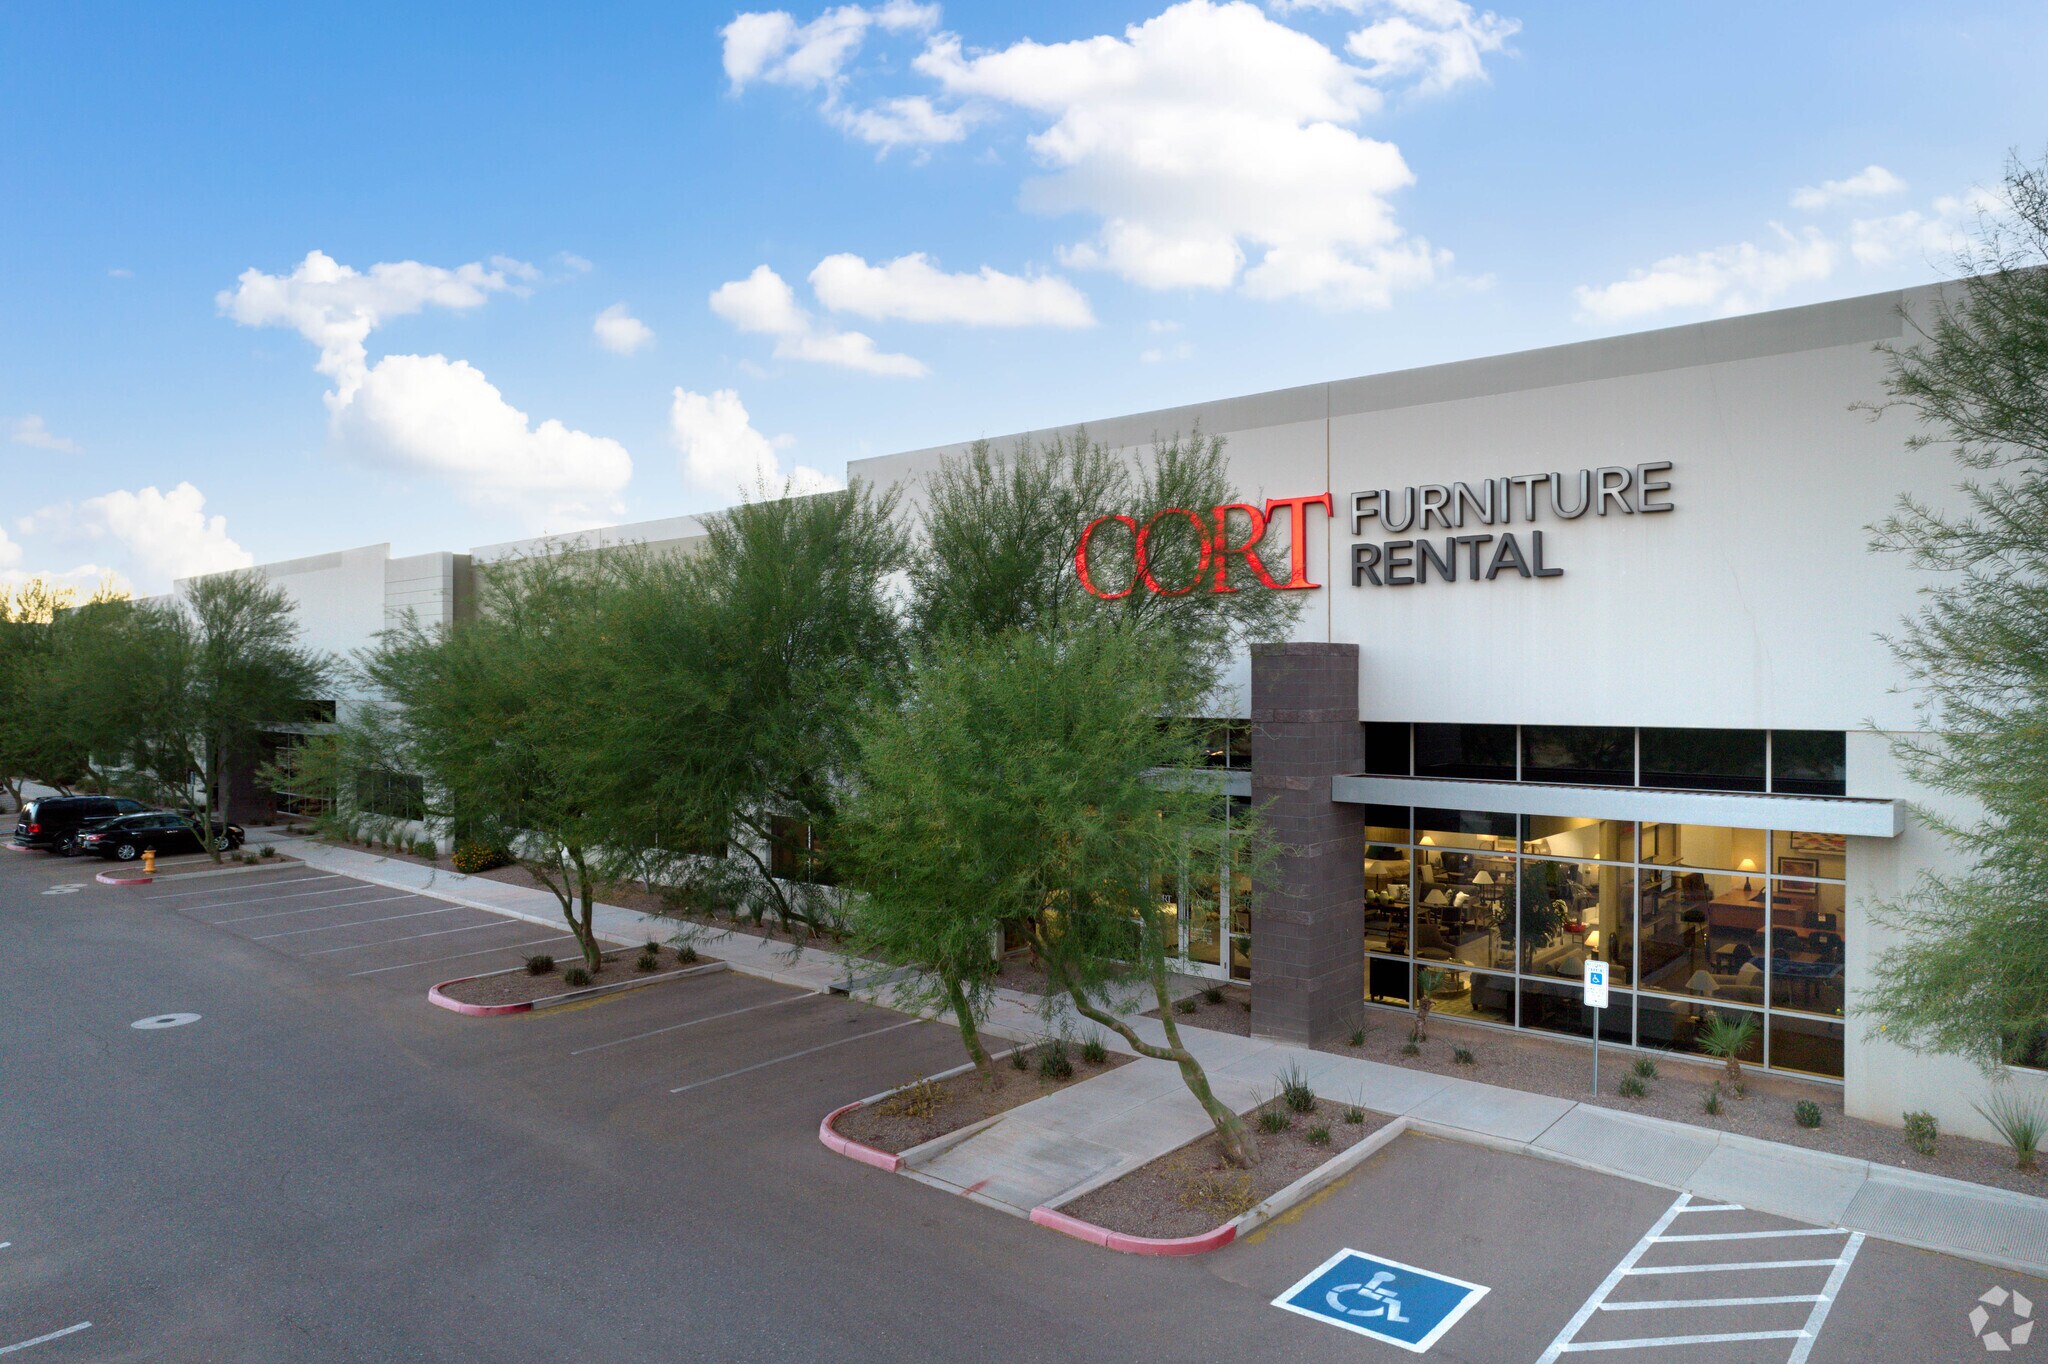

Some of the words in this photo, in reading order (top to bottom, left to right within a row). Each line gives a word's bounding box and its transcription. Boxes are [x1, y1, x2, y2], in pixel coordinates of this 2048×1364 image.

[1350, 460, 1674, 535] FURNITURE
[1075, 491, 1334, 599] CORT
[1351, 530, 1564, 587] RENTAL
